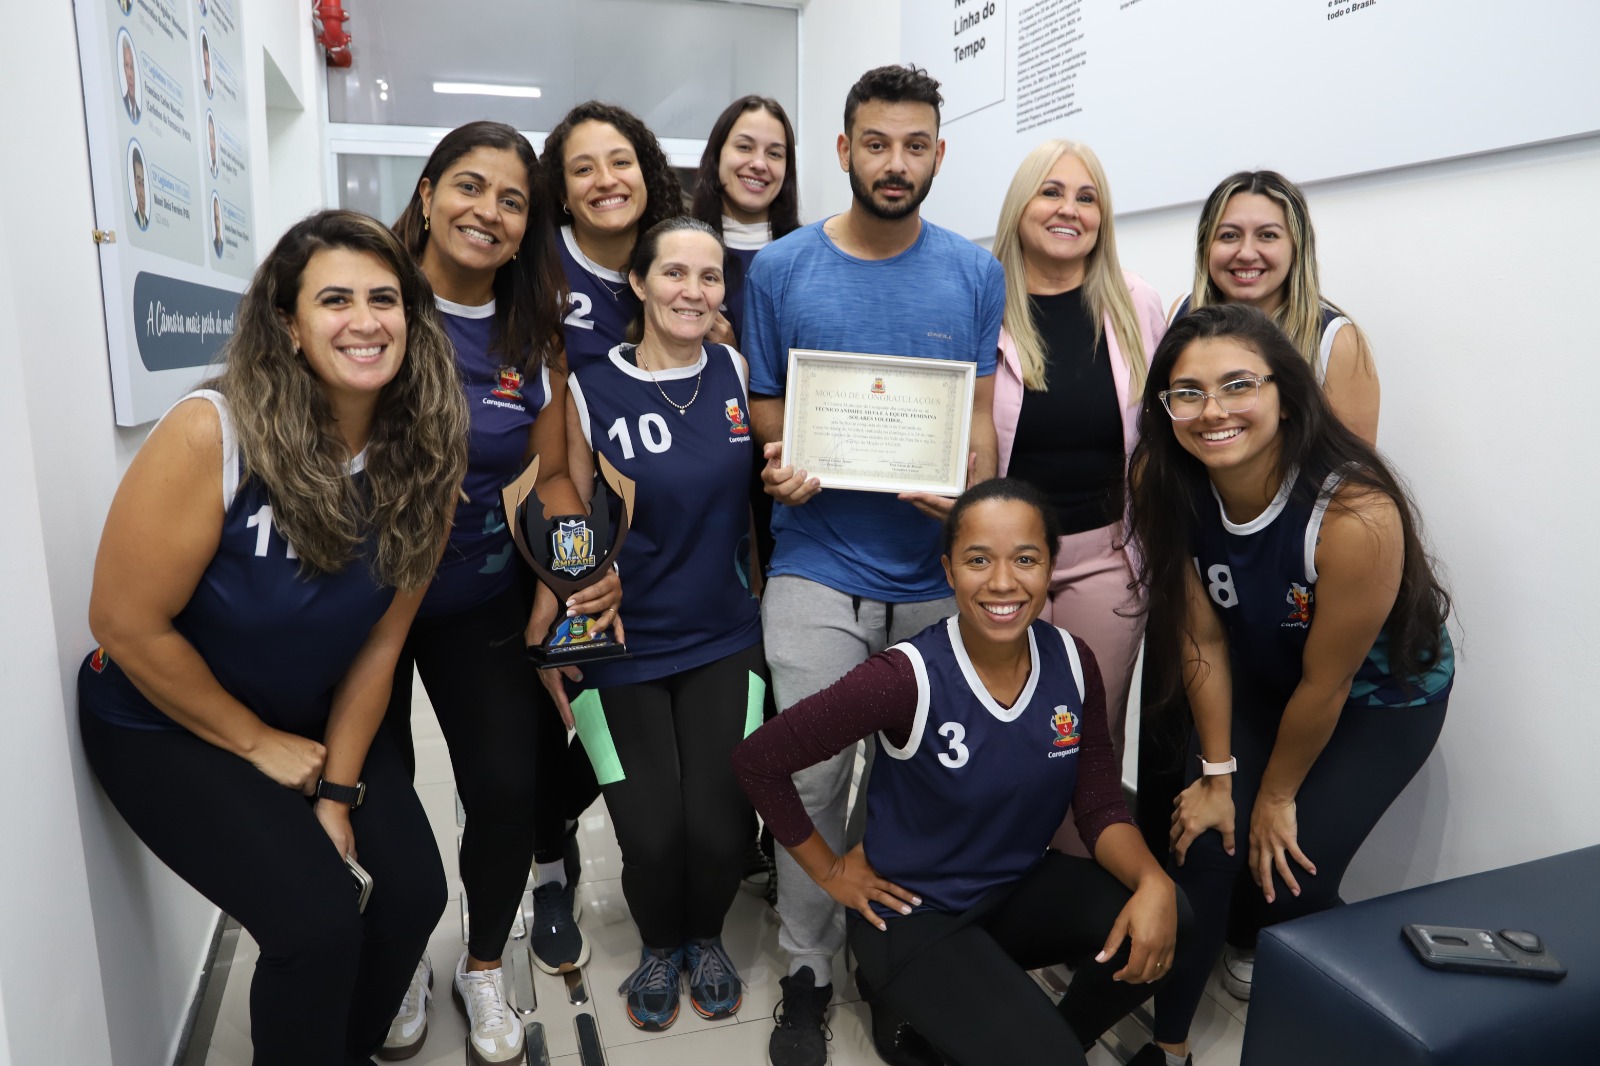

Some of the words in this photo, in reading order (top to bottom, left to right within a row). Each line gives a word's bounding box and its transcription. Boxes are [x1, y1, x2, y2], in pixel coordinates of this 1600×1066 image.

[954, 11, 980, 36] Linha
[982, 0, 995, 20] do
[1327, 9, 1344, 20] todo
[1351, 0, 1377, 12] Brasil.
[954, 37, 986, 63] Tempo
[146, 300, 155, 338] A
[155, 300, 185, 337] Câmara
[185, 311, 201, 334] mais
[201, 310, 215, 344] perto
[215, 309, 222, 335] de
[815, 389, 847, 399] MOÇÃO
[862, 392, 941, 405] CONGRATULAÇÕES
[607, 412, 672, 460] 10
[246, 504, 298, 559] 1
[553, 557, 595, 568] AMIZADE
[1207, 563, 1239, 609] 8
[937, 721, 970, 769] 3
